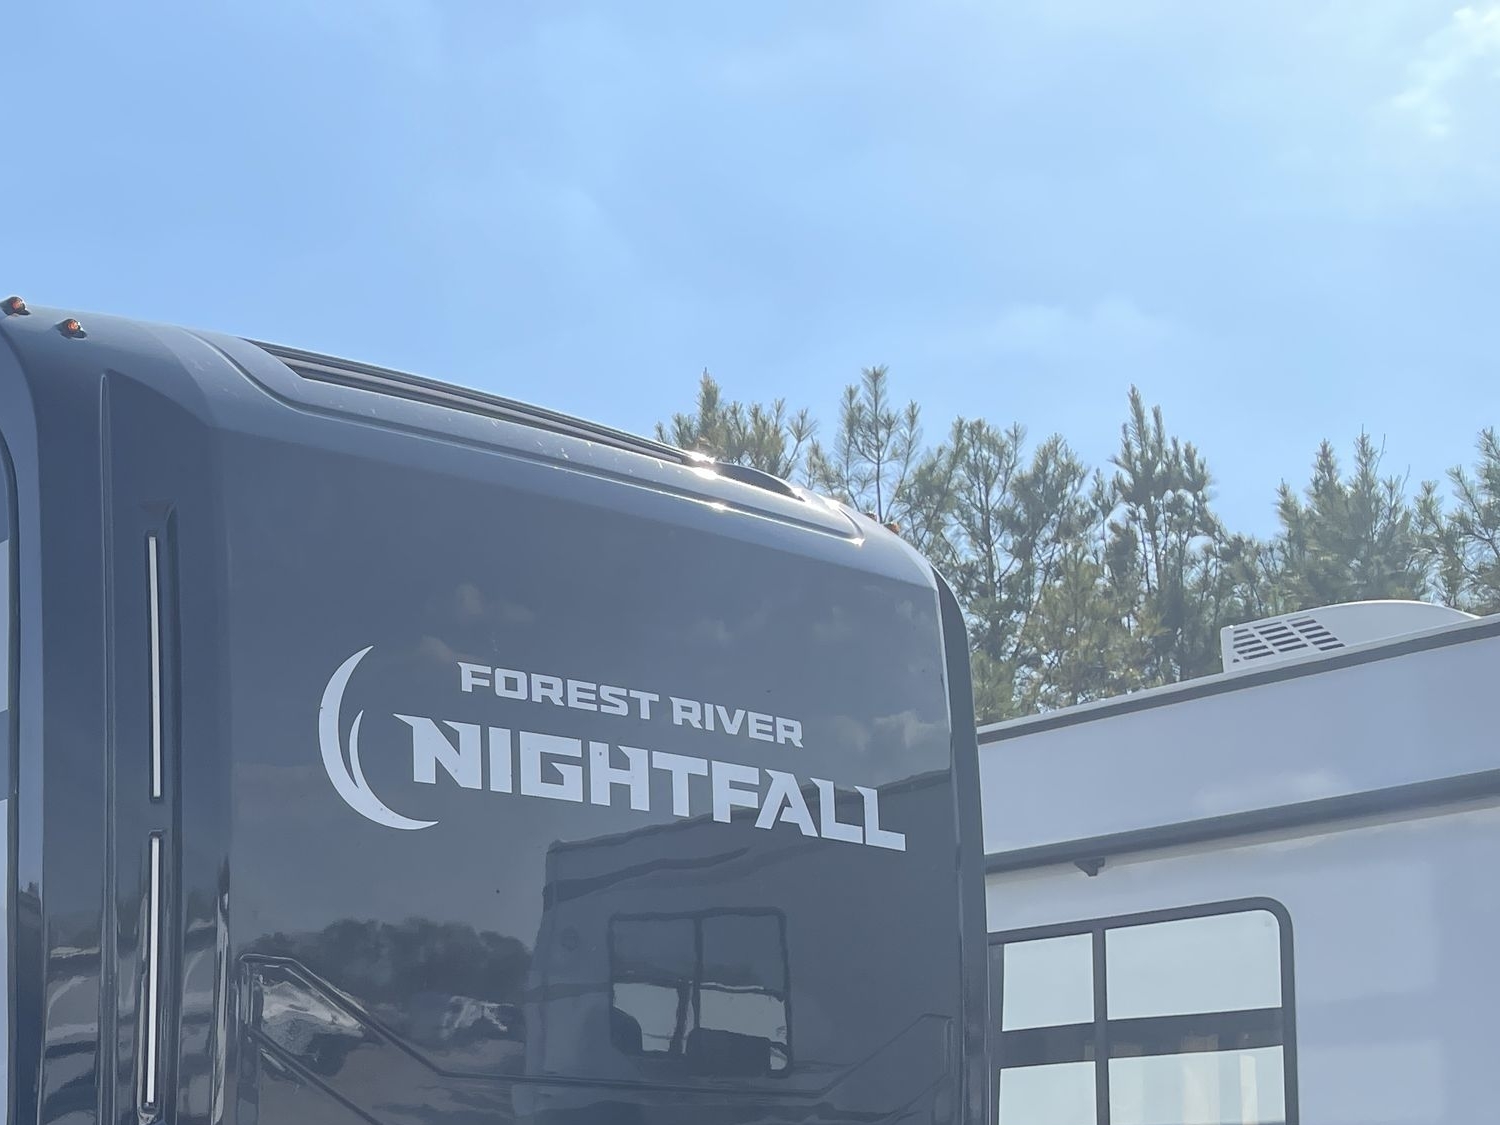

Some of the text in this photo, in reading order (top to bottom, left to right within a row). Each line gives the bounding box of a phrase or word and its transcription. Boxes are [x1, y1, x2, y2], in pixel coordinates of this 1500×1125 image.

[457, 661, 804, 748] FOREST RIVER
[393, 713, 906, 852] NIGHTFALL
